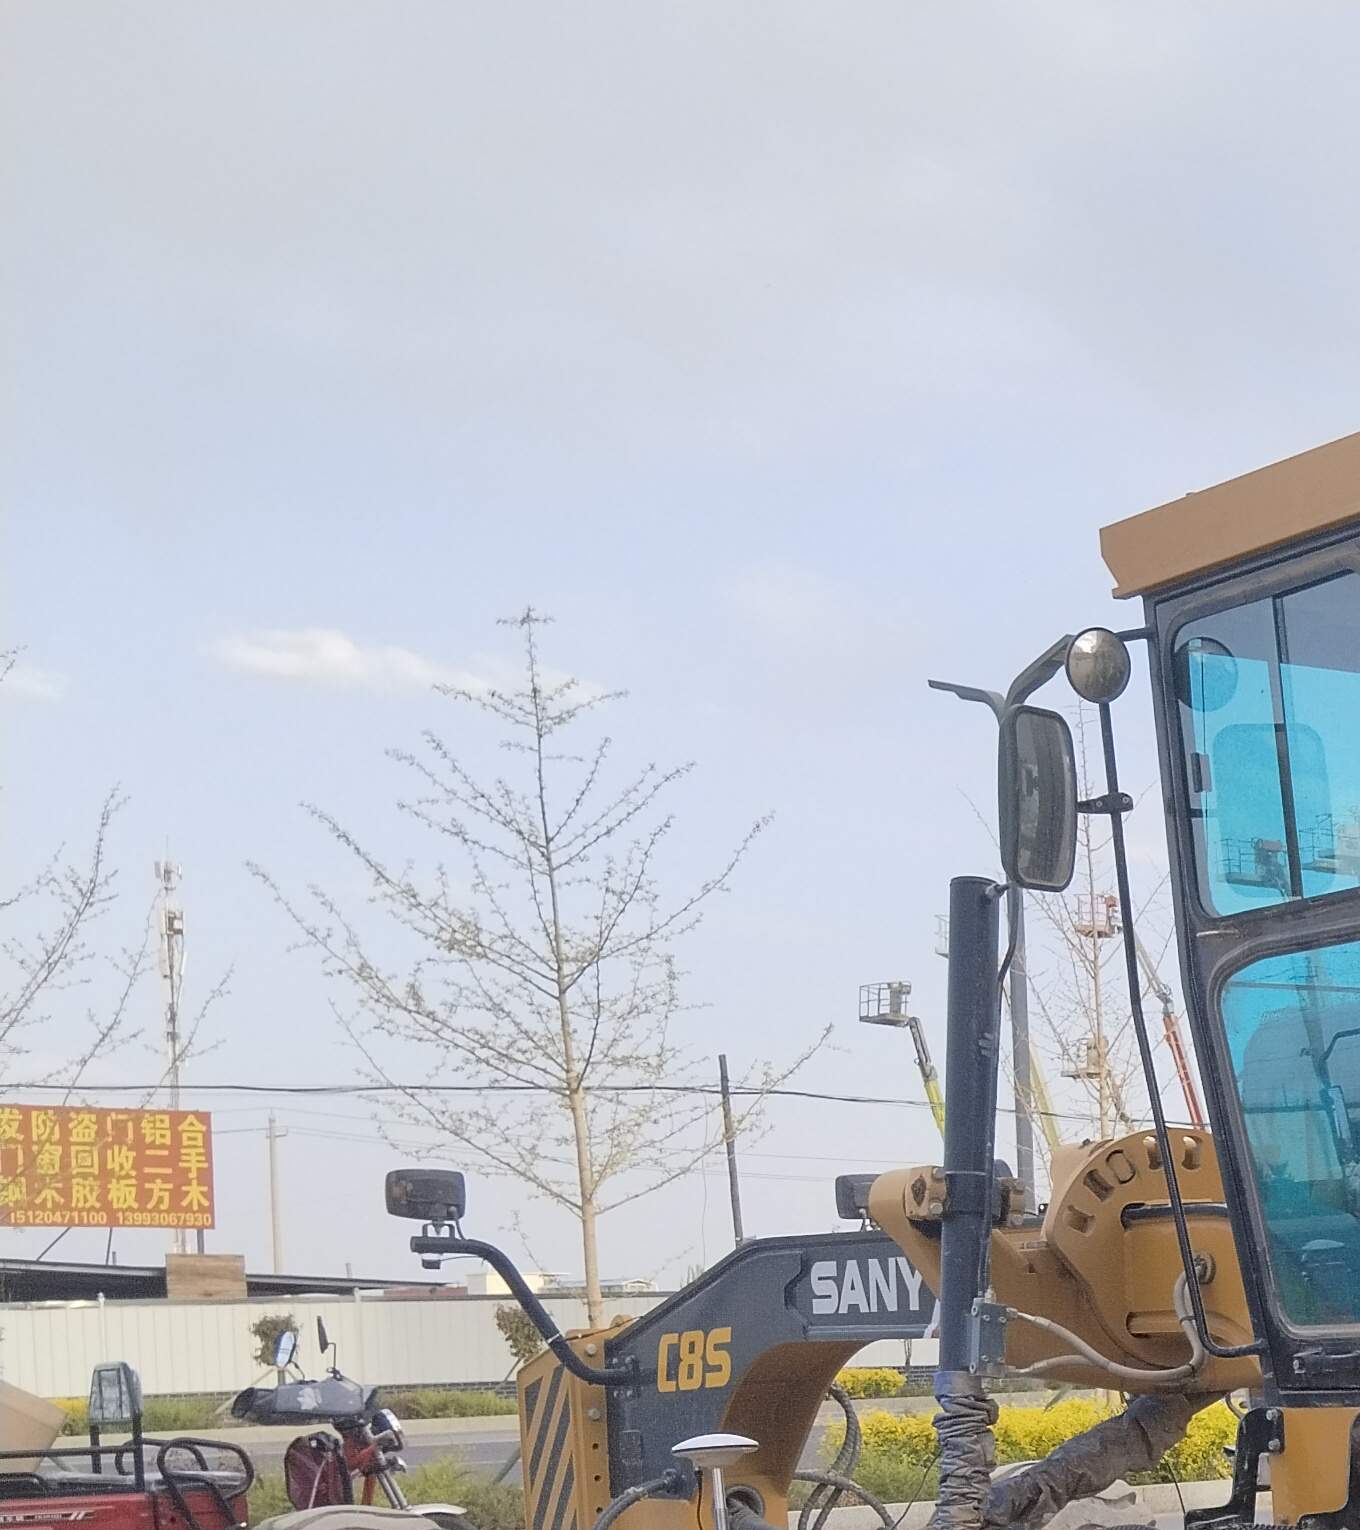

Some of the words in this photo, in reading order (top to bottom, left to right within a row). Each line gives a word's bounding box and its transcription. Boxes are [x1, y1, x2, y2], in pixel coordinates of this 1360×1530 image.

[10, 1211, 107, 1224] 15120471100
[117, 1211, 211, 1226] 13993067930
[810, 1256, 923, 1314] SANY
